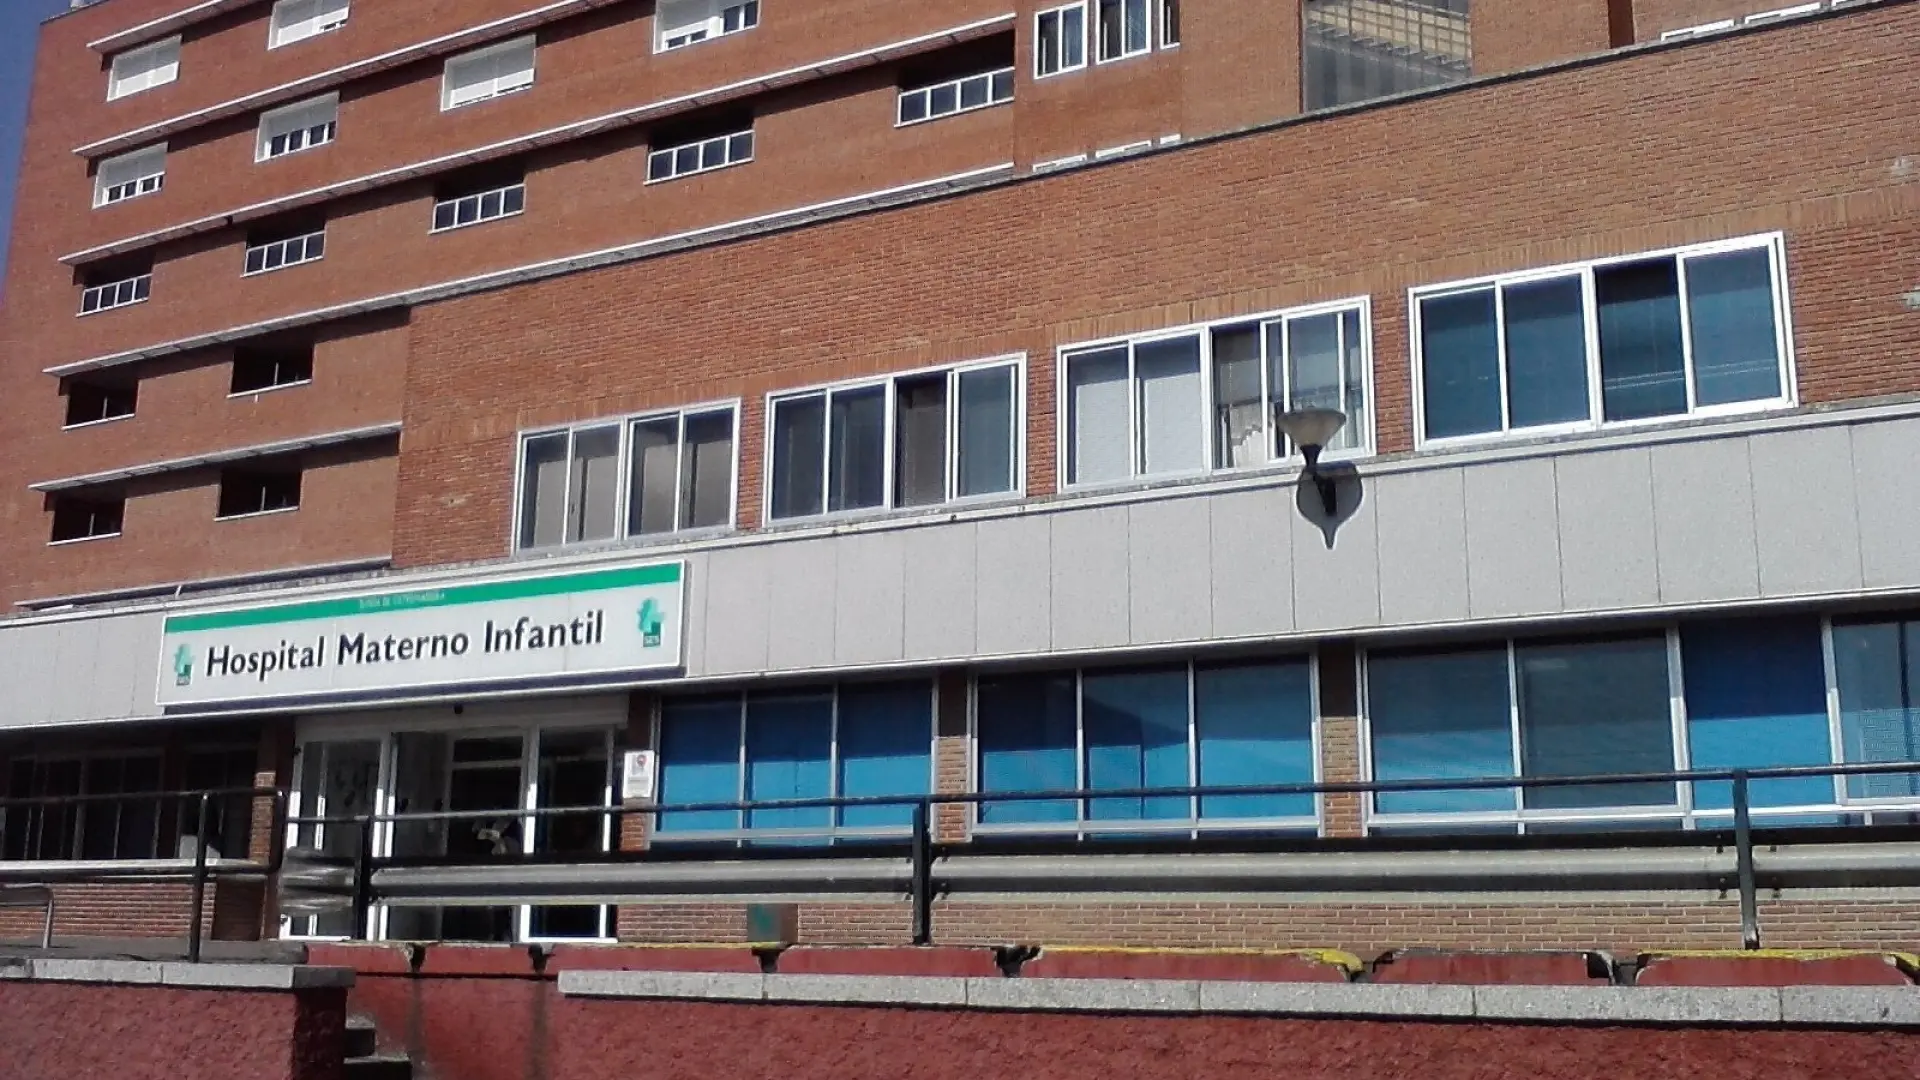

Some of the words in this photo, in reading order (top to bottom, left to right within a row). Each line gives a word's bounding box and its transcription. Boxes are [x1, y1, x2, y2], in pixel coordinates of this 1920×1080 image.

[206, 635, 325, 682] Hospital
[337, 632, 469, 665] Materno
[484, 609, 604, 653] Infantil
